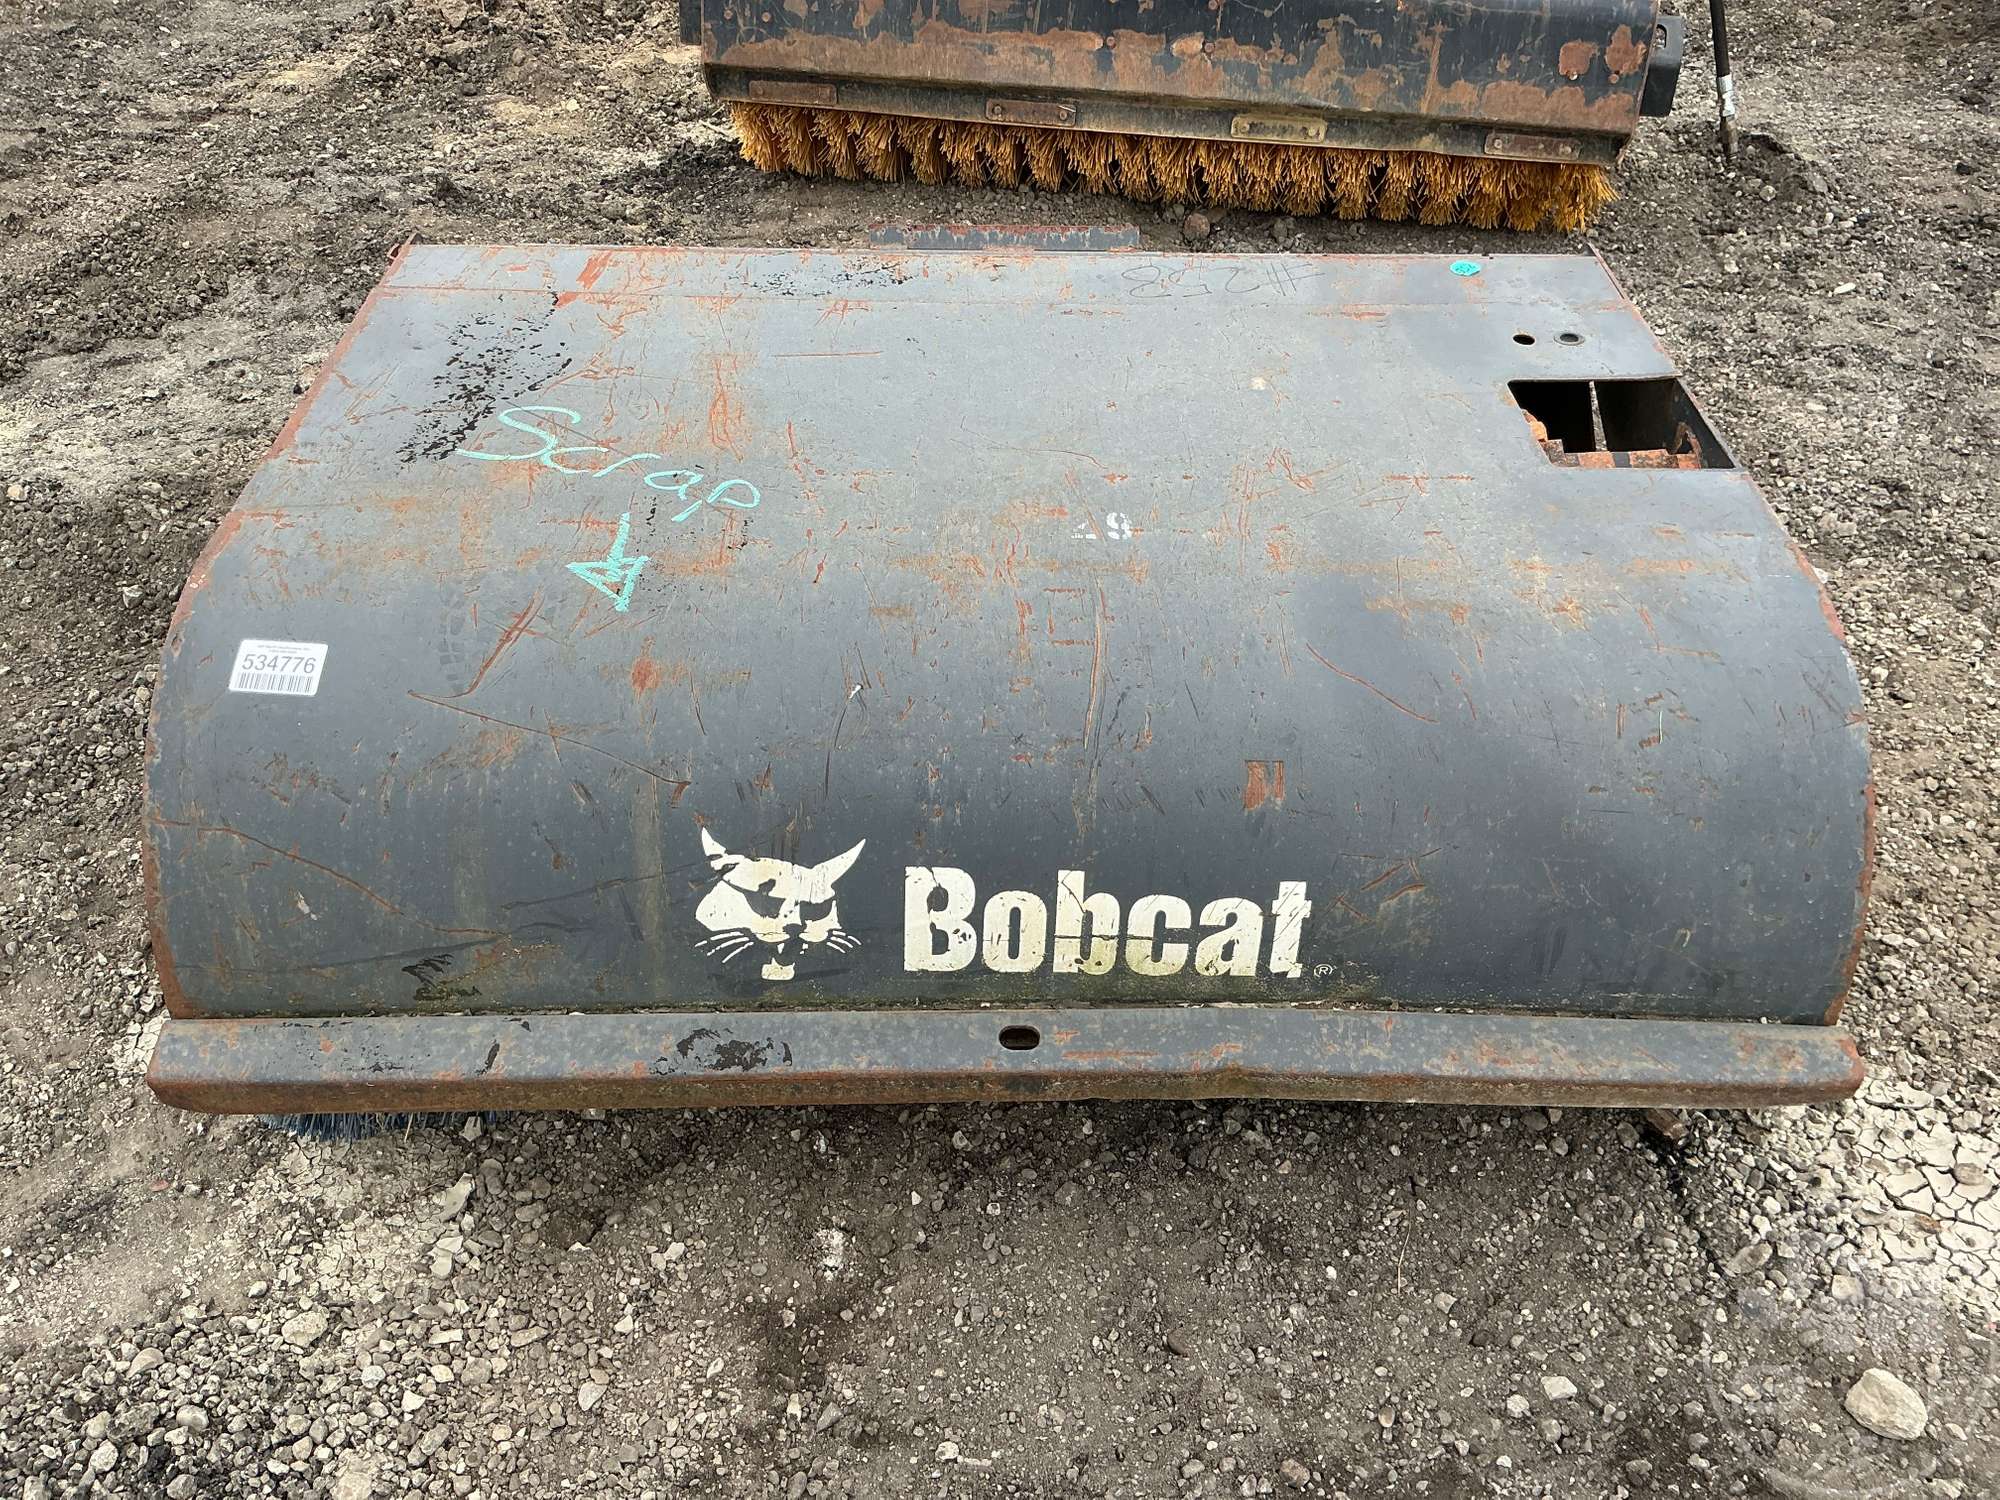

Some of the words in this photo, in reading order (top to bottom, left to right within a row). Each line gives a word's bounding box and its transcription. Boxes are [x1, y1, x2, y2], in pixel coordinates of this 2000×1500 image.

[456, 405, 761, 522] Scrap
[241, 653, 316, 674] 534776
[903, 866, 1312, 979] Bobcat
